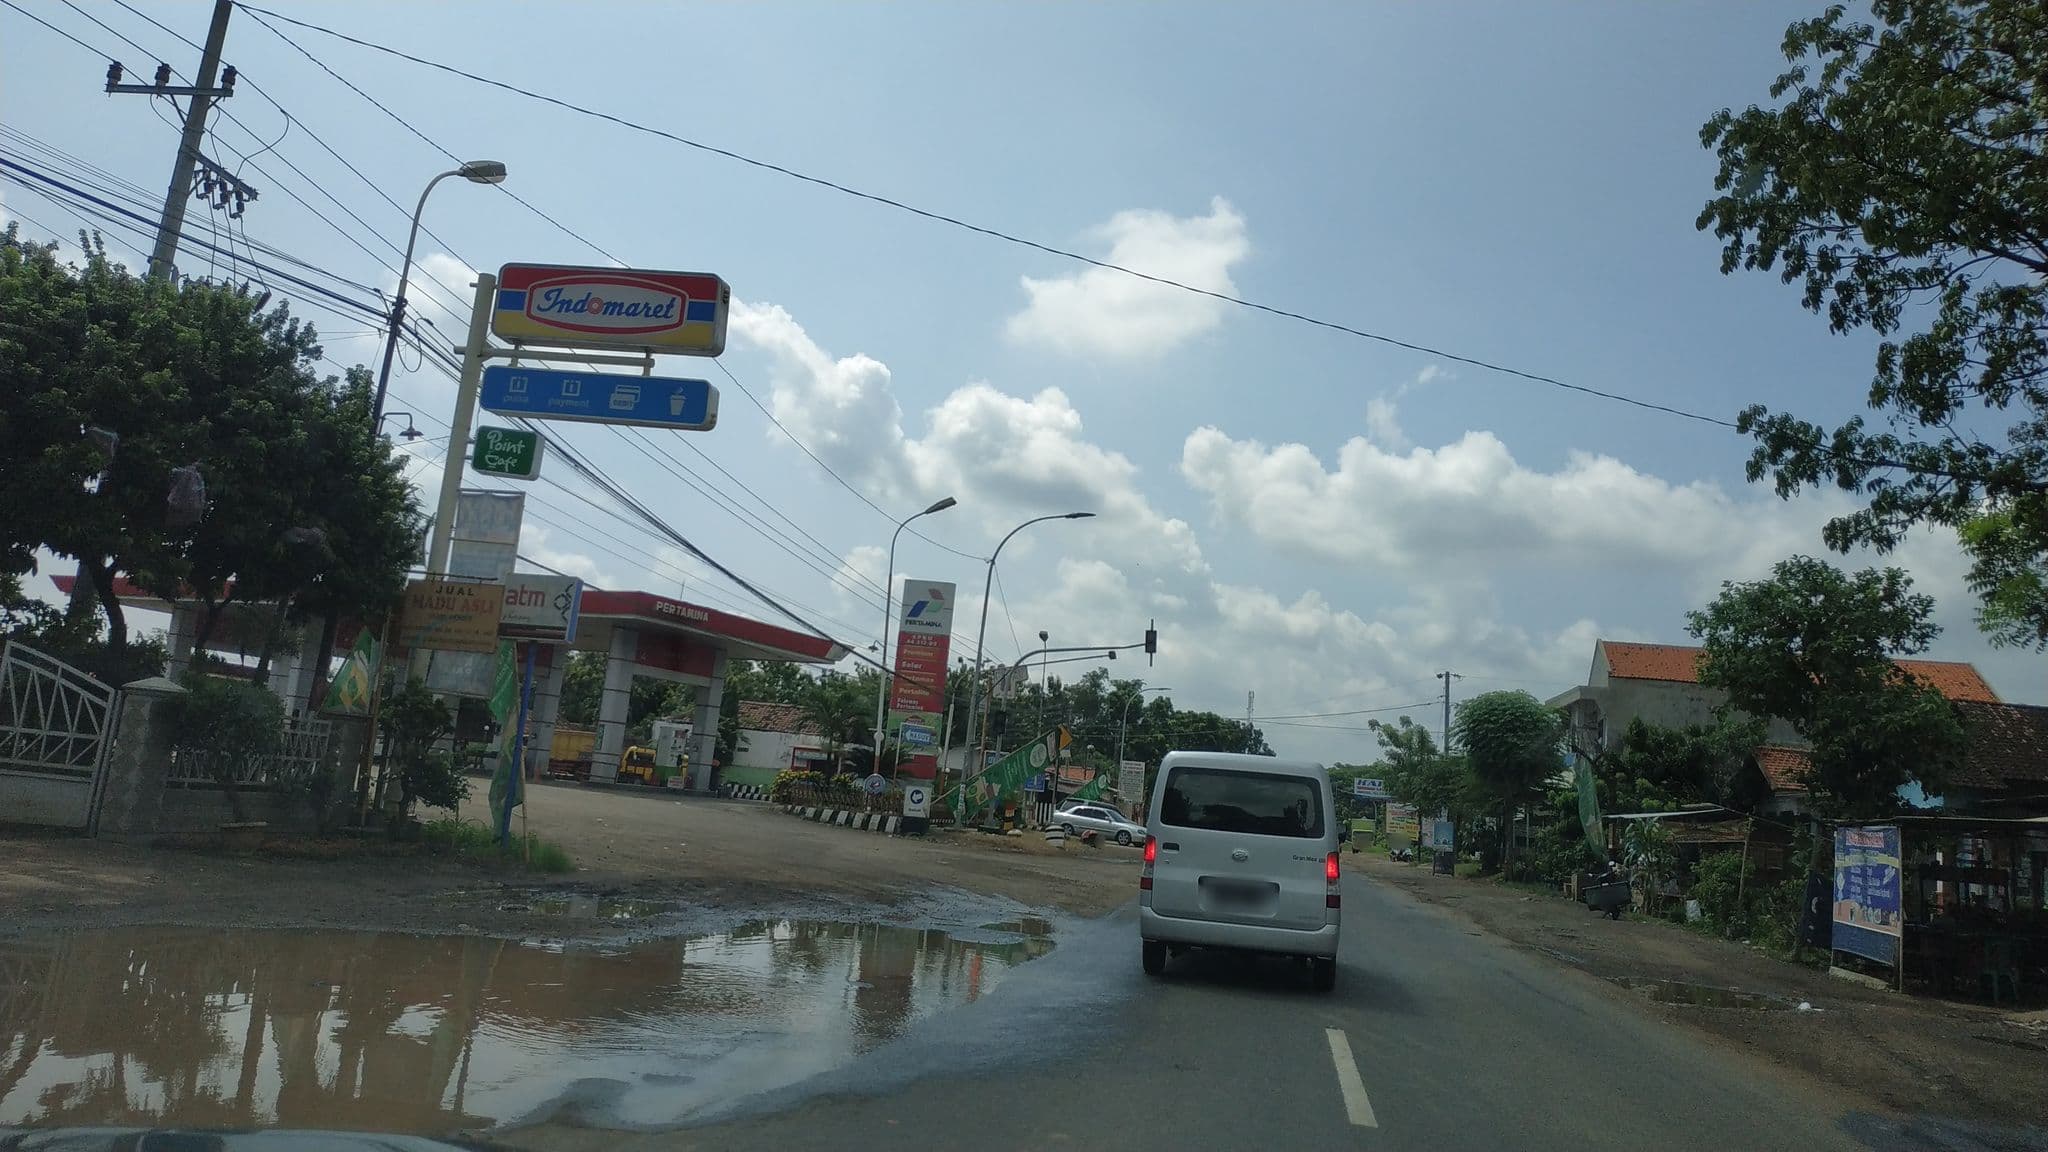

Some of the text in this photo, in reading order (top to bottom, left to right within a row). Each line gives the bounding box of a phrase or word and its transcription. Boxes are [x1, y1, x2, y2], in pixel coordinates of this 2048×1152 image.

[536, 287, 677, 319] Indomaret
[486, 430, 525, 454] Point
[435, 585, 475, 596] JUAL
[505, 584, 546, 607] atm
[656, 600, 709, 623] PERTAMINA
